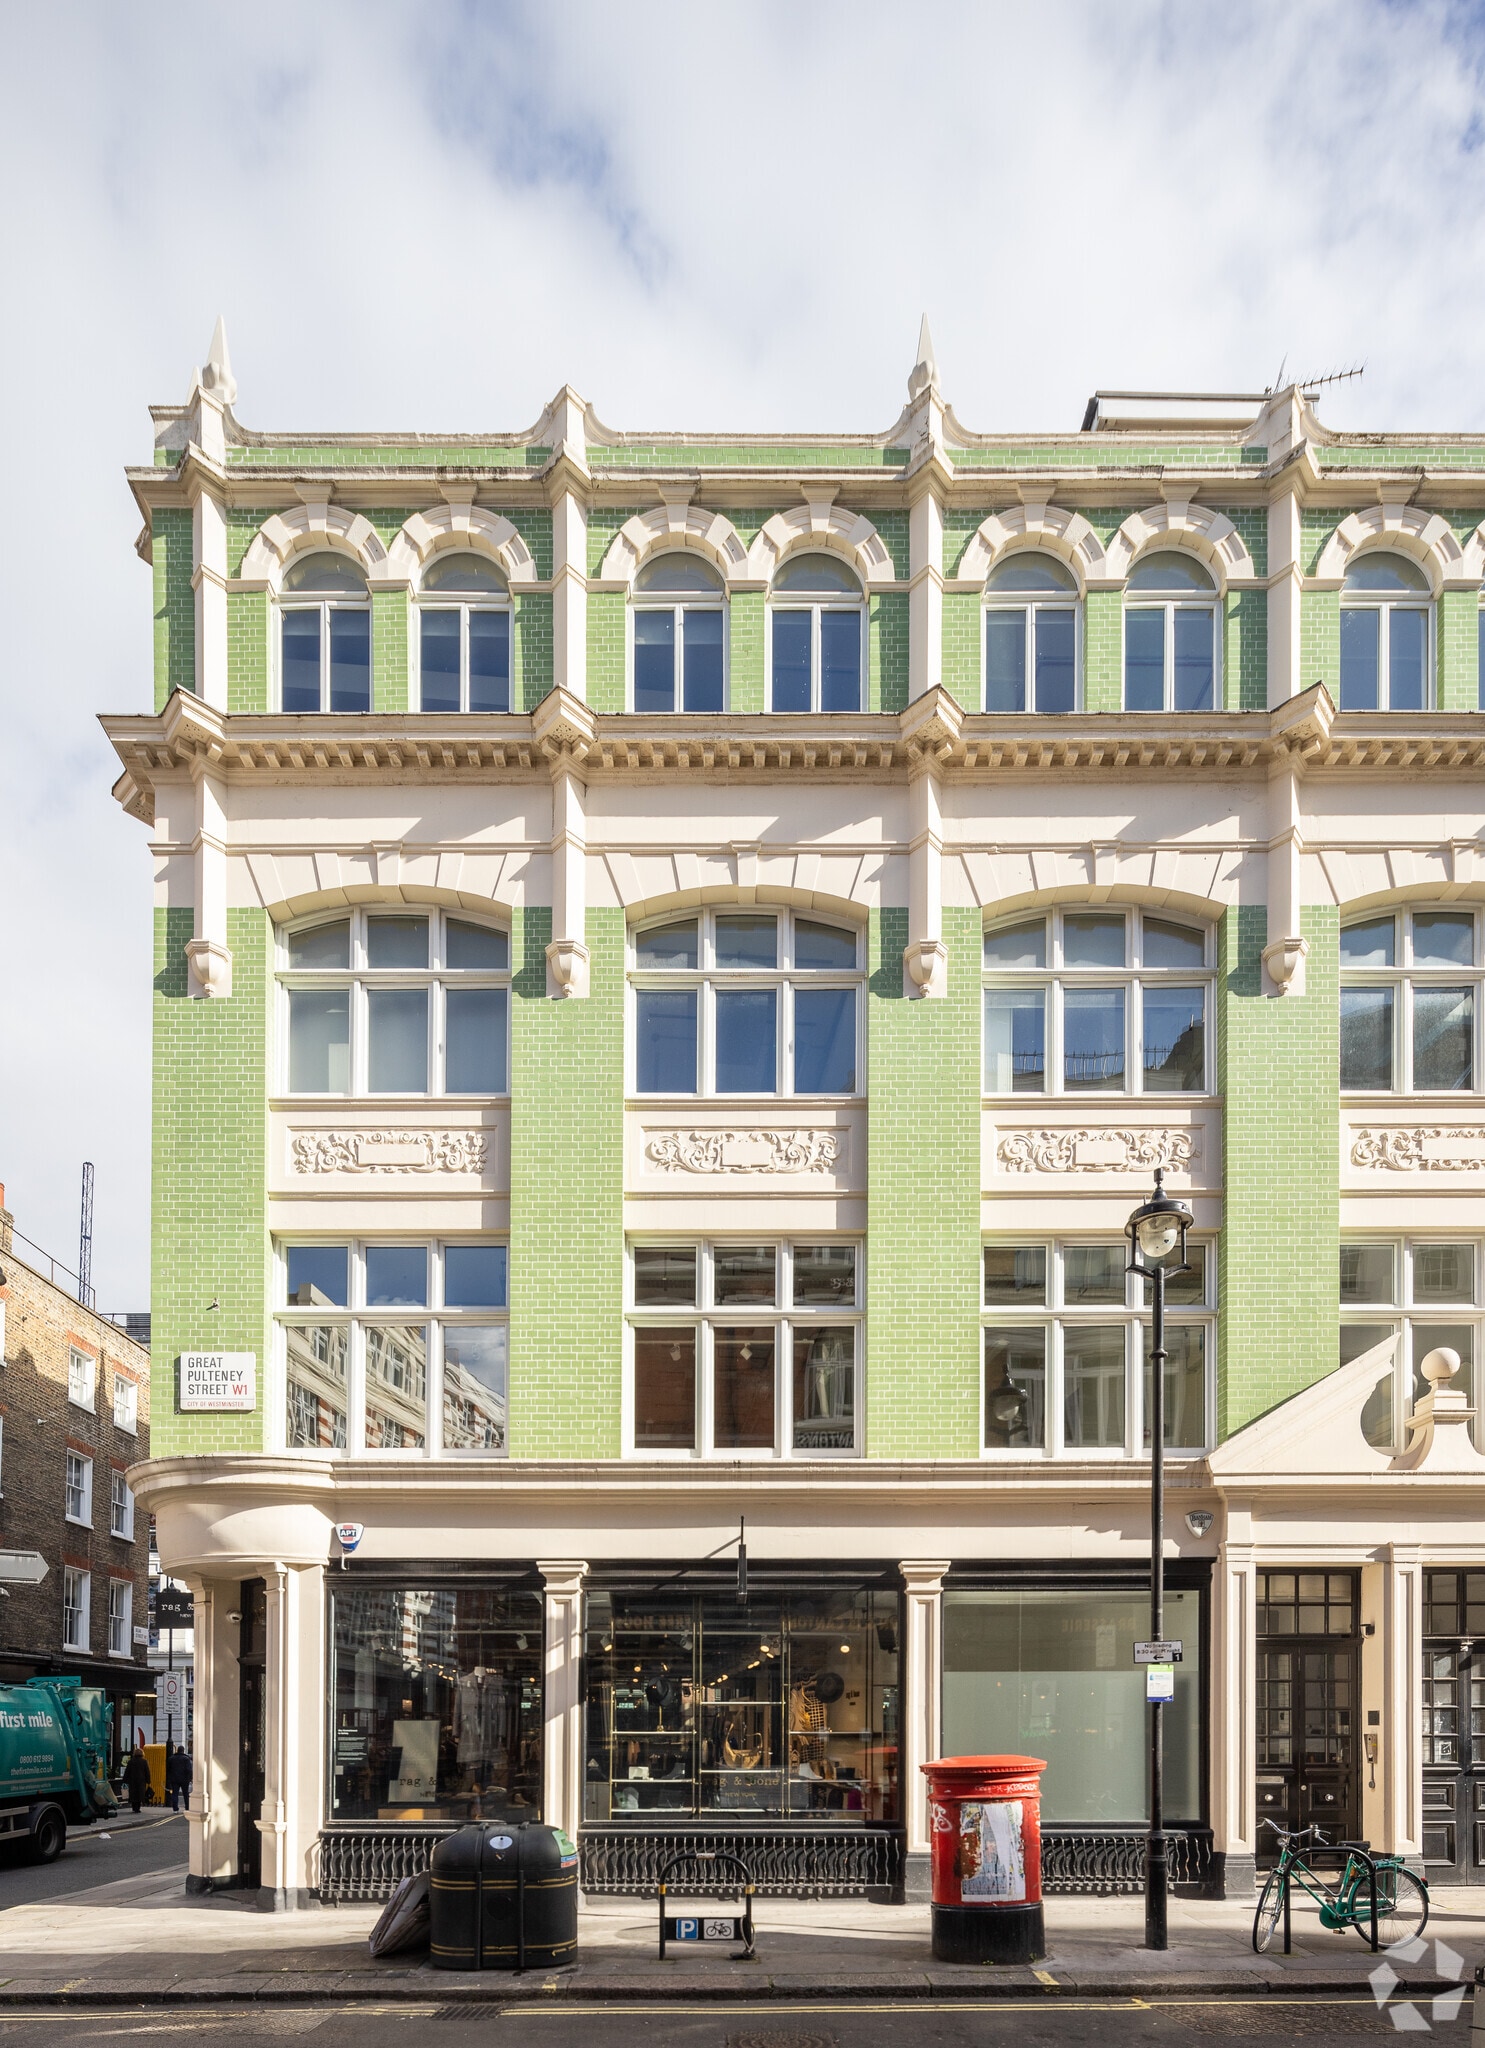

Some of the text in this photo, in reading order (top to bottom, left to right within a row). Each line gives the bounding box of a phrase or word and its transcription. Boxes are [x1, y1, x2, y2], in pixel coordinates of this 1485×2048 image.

[188, 1357, 223, 1368] GREAT
[187, 1370, 243, 1381] PULTENEY
[188, 1384, 248, 1395] STREET W1
[162, 1603, 181, 1613] rag
[1175, 1653, 1181, 1662] 1
[0, 1711, 54, 1728] first mile
[20, 1756, 33, 1764] 0800
[33, 1755, 42, 1763] 612
[11, 1765, 54, 1776] thefirstmile.co.uk
[399, 1778, 421, 1787] rag
[733, 1776, 743, 1786] &
[681, 1920, 695, 1938] P
